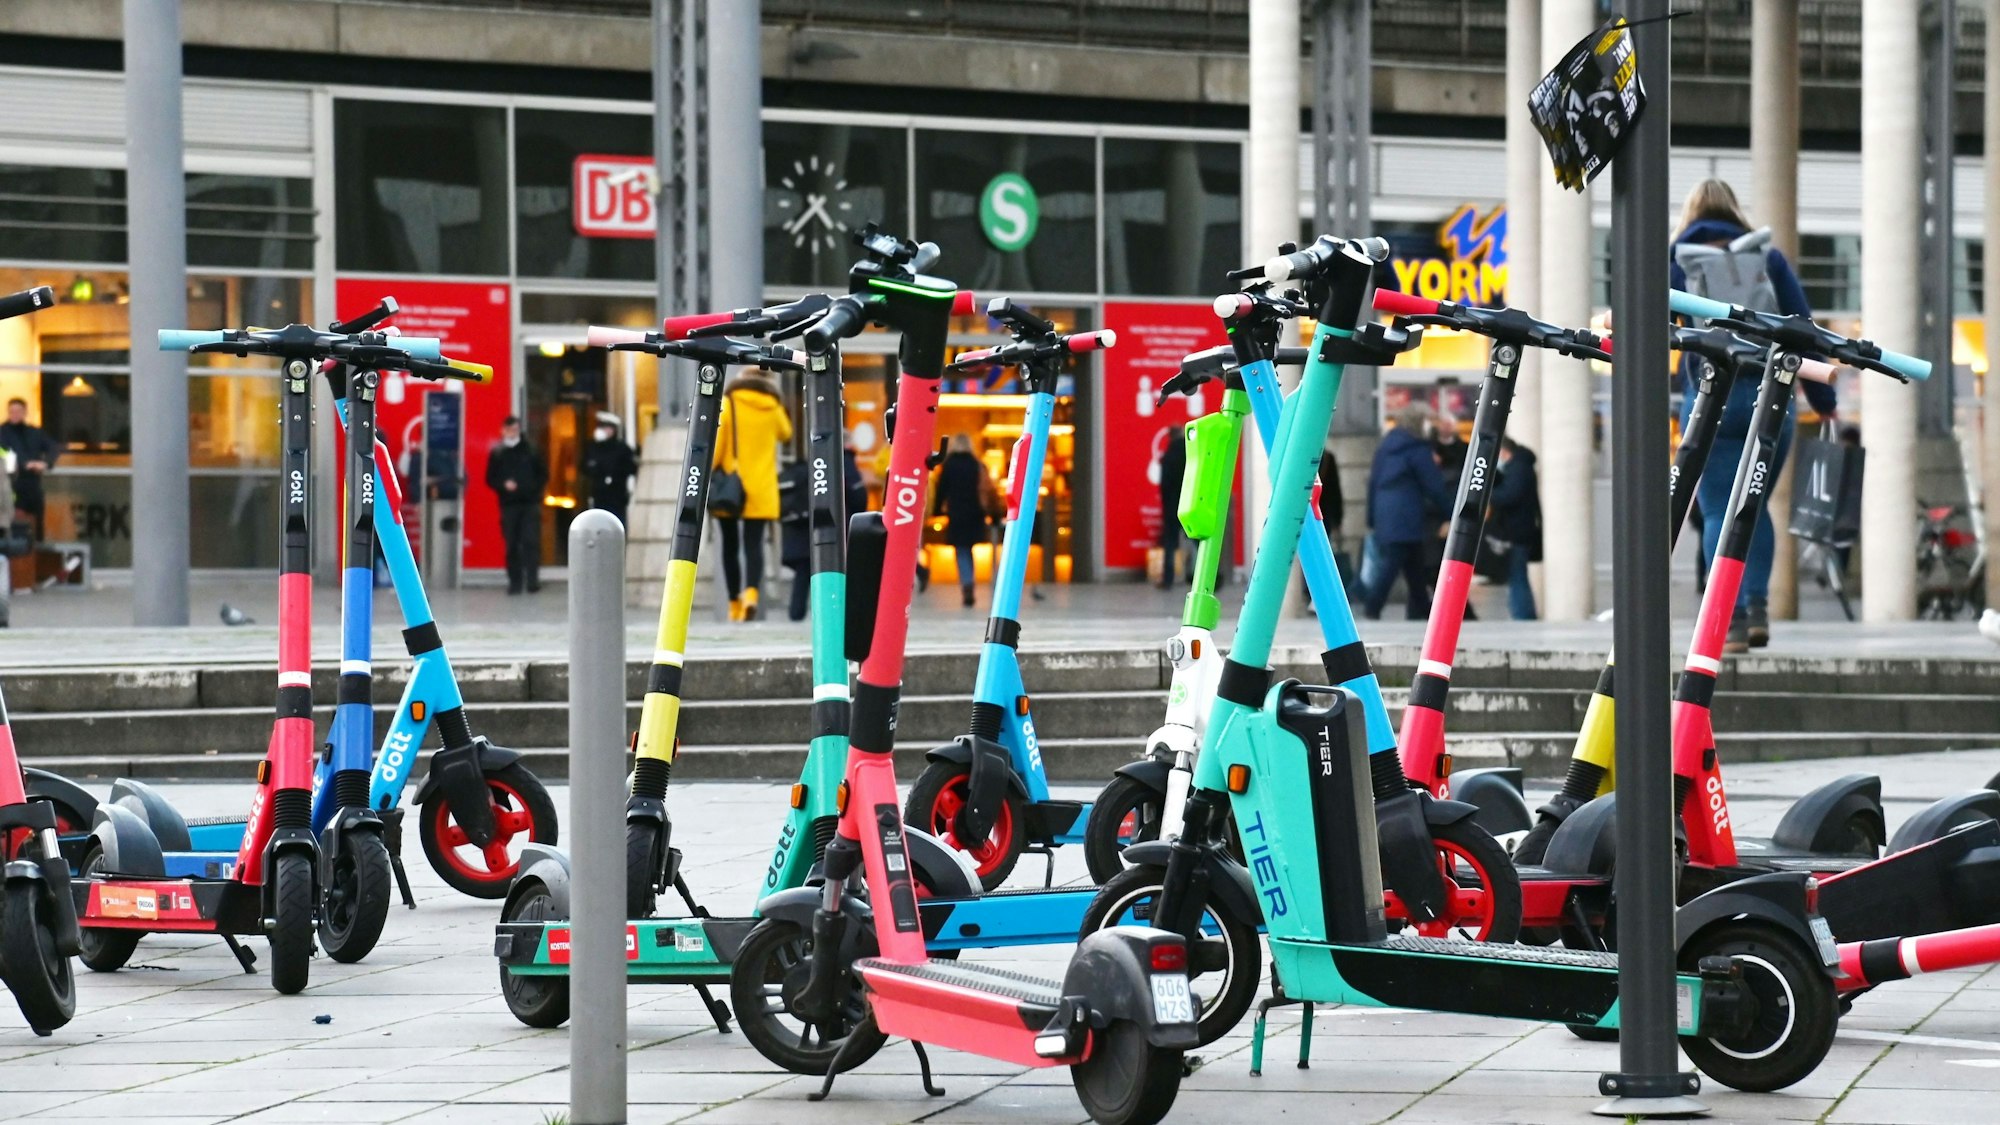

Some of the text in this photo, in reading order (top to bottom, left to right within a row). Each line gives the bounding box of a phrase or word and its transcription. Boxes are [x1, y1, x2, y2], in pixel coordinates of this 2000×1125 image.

[588, 170, 651, 223] DB
[992, 182, 1028, 243] S
[1392, 259, 1507, 304] YORM
[290, 470, 304, 504] dott
[362, 473, 374, 504] dott
[685, 465, 701, 497] dott
[813, 457, 828, 496] dott
[894, 468, 920, 526] voi.
[1470, 457, 1488, 491] dott
[1748, 461, 1767, 495] dott
[381, 731, 413, 782] dott
[1022, 721, 1042, 772] dott
[1318, 725, 1333, 777] TIER
[244, 791, 265, 851] dott
[1706, 776, 1729, 836] dott
[767, 824, 796, 889] dott
[1245, 810, 1288, 921] TIER
[1157, 978, 1184, 997] 606
[1159, 1001, 1189, 1019] HZS
